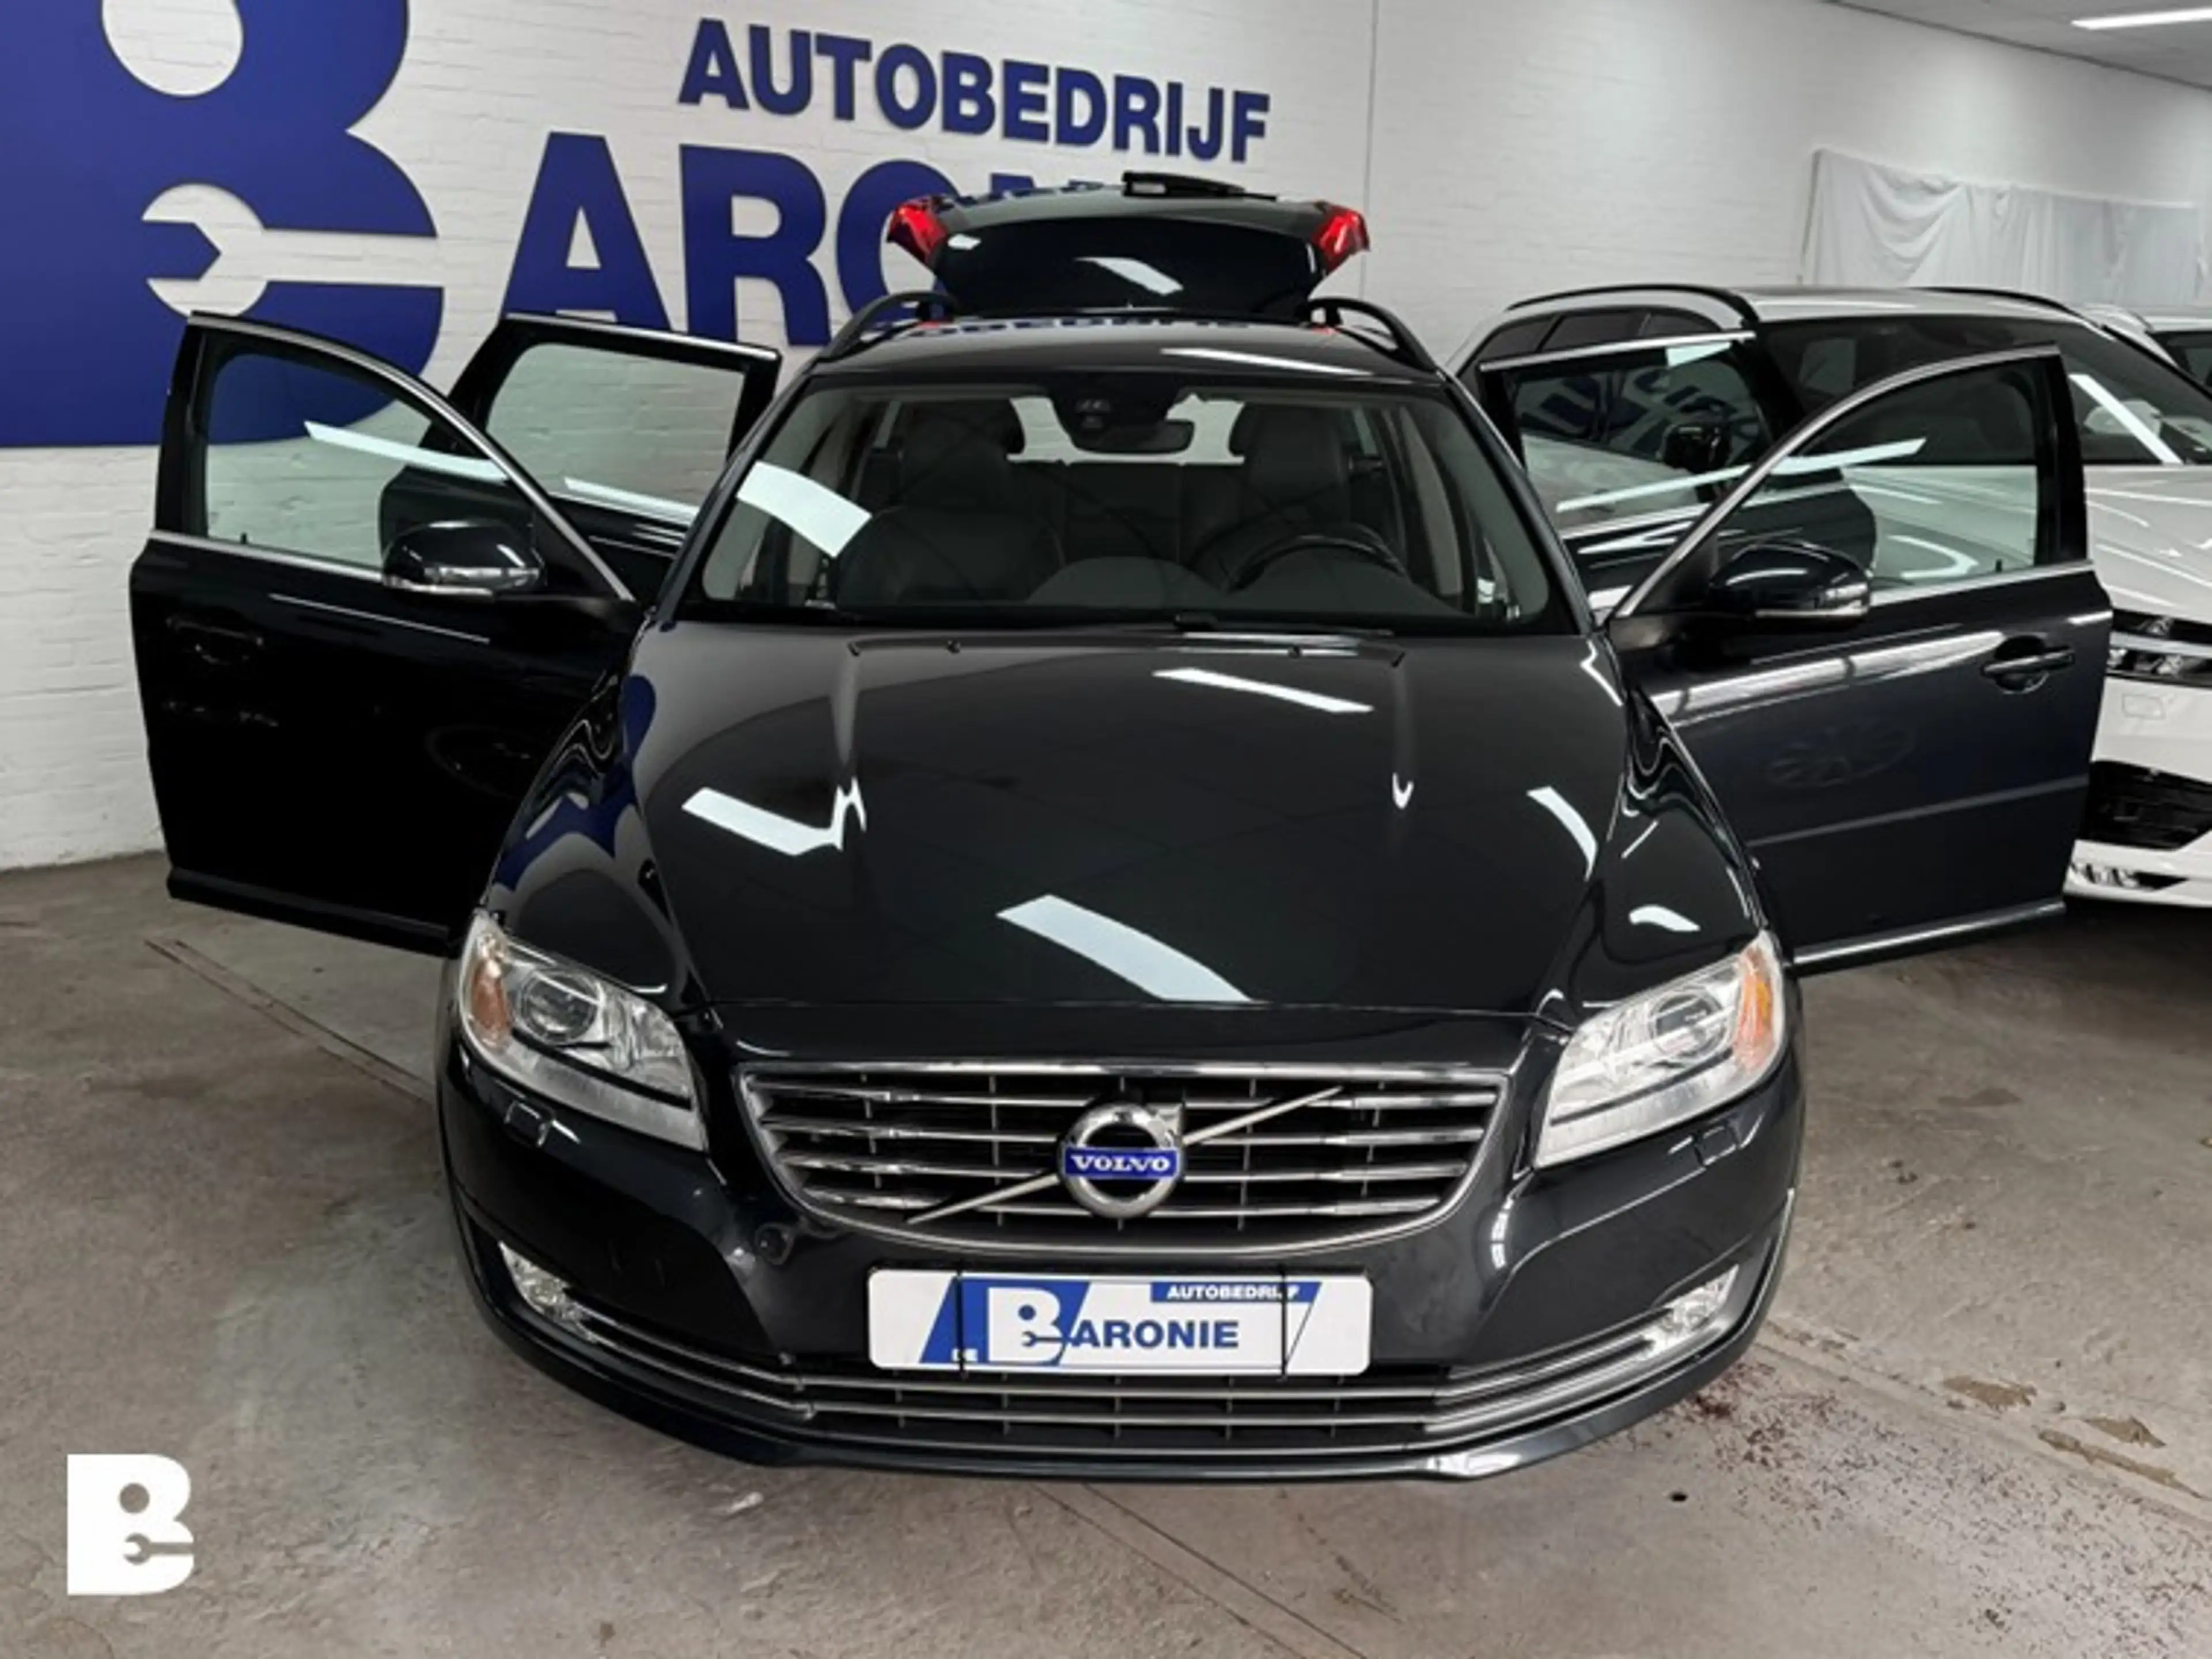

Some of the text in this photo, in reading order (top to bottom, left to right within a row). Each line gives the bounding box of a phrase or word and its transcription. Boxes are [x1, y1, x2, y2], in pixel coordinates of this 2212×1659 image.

[679, 18, 1270, 162] AUTOBEDRIJF
[1070, 1154, 1171, 1172] VOLVO
[1167, 1285, 1300, 1300] AUTOBEDRIF
